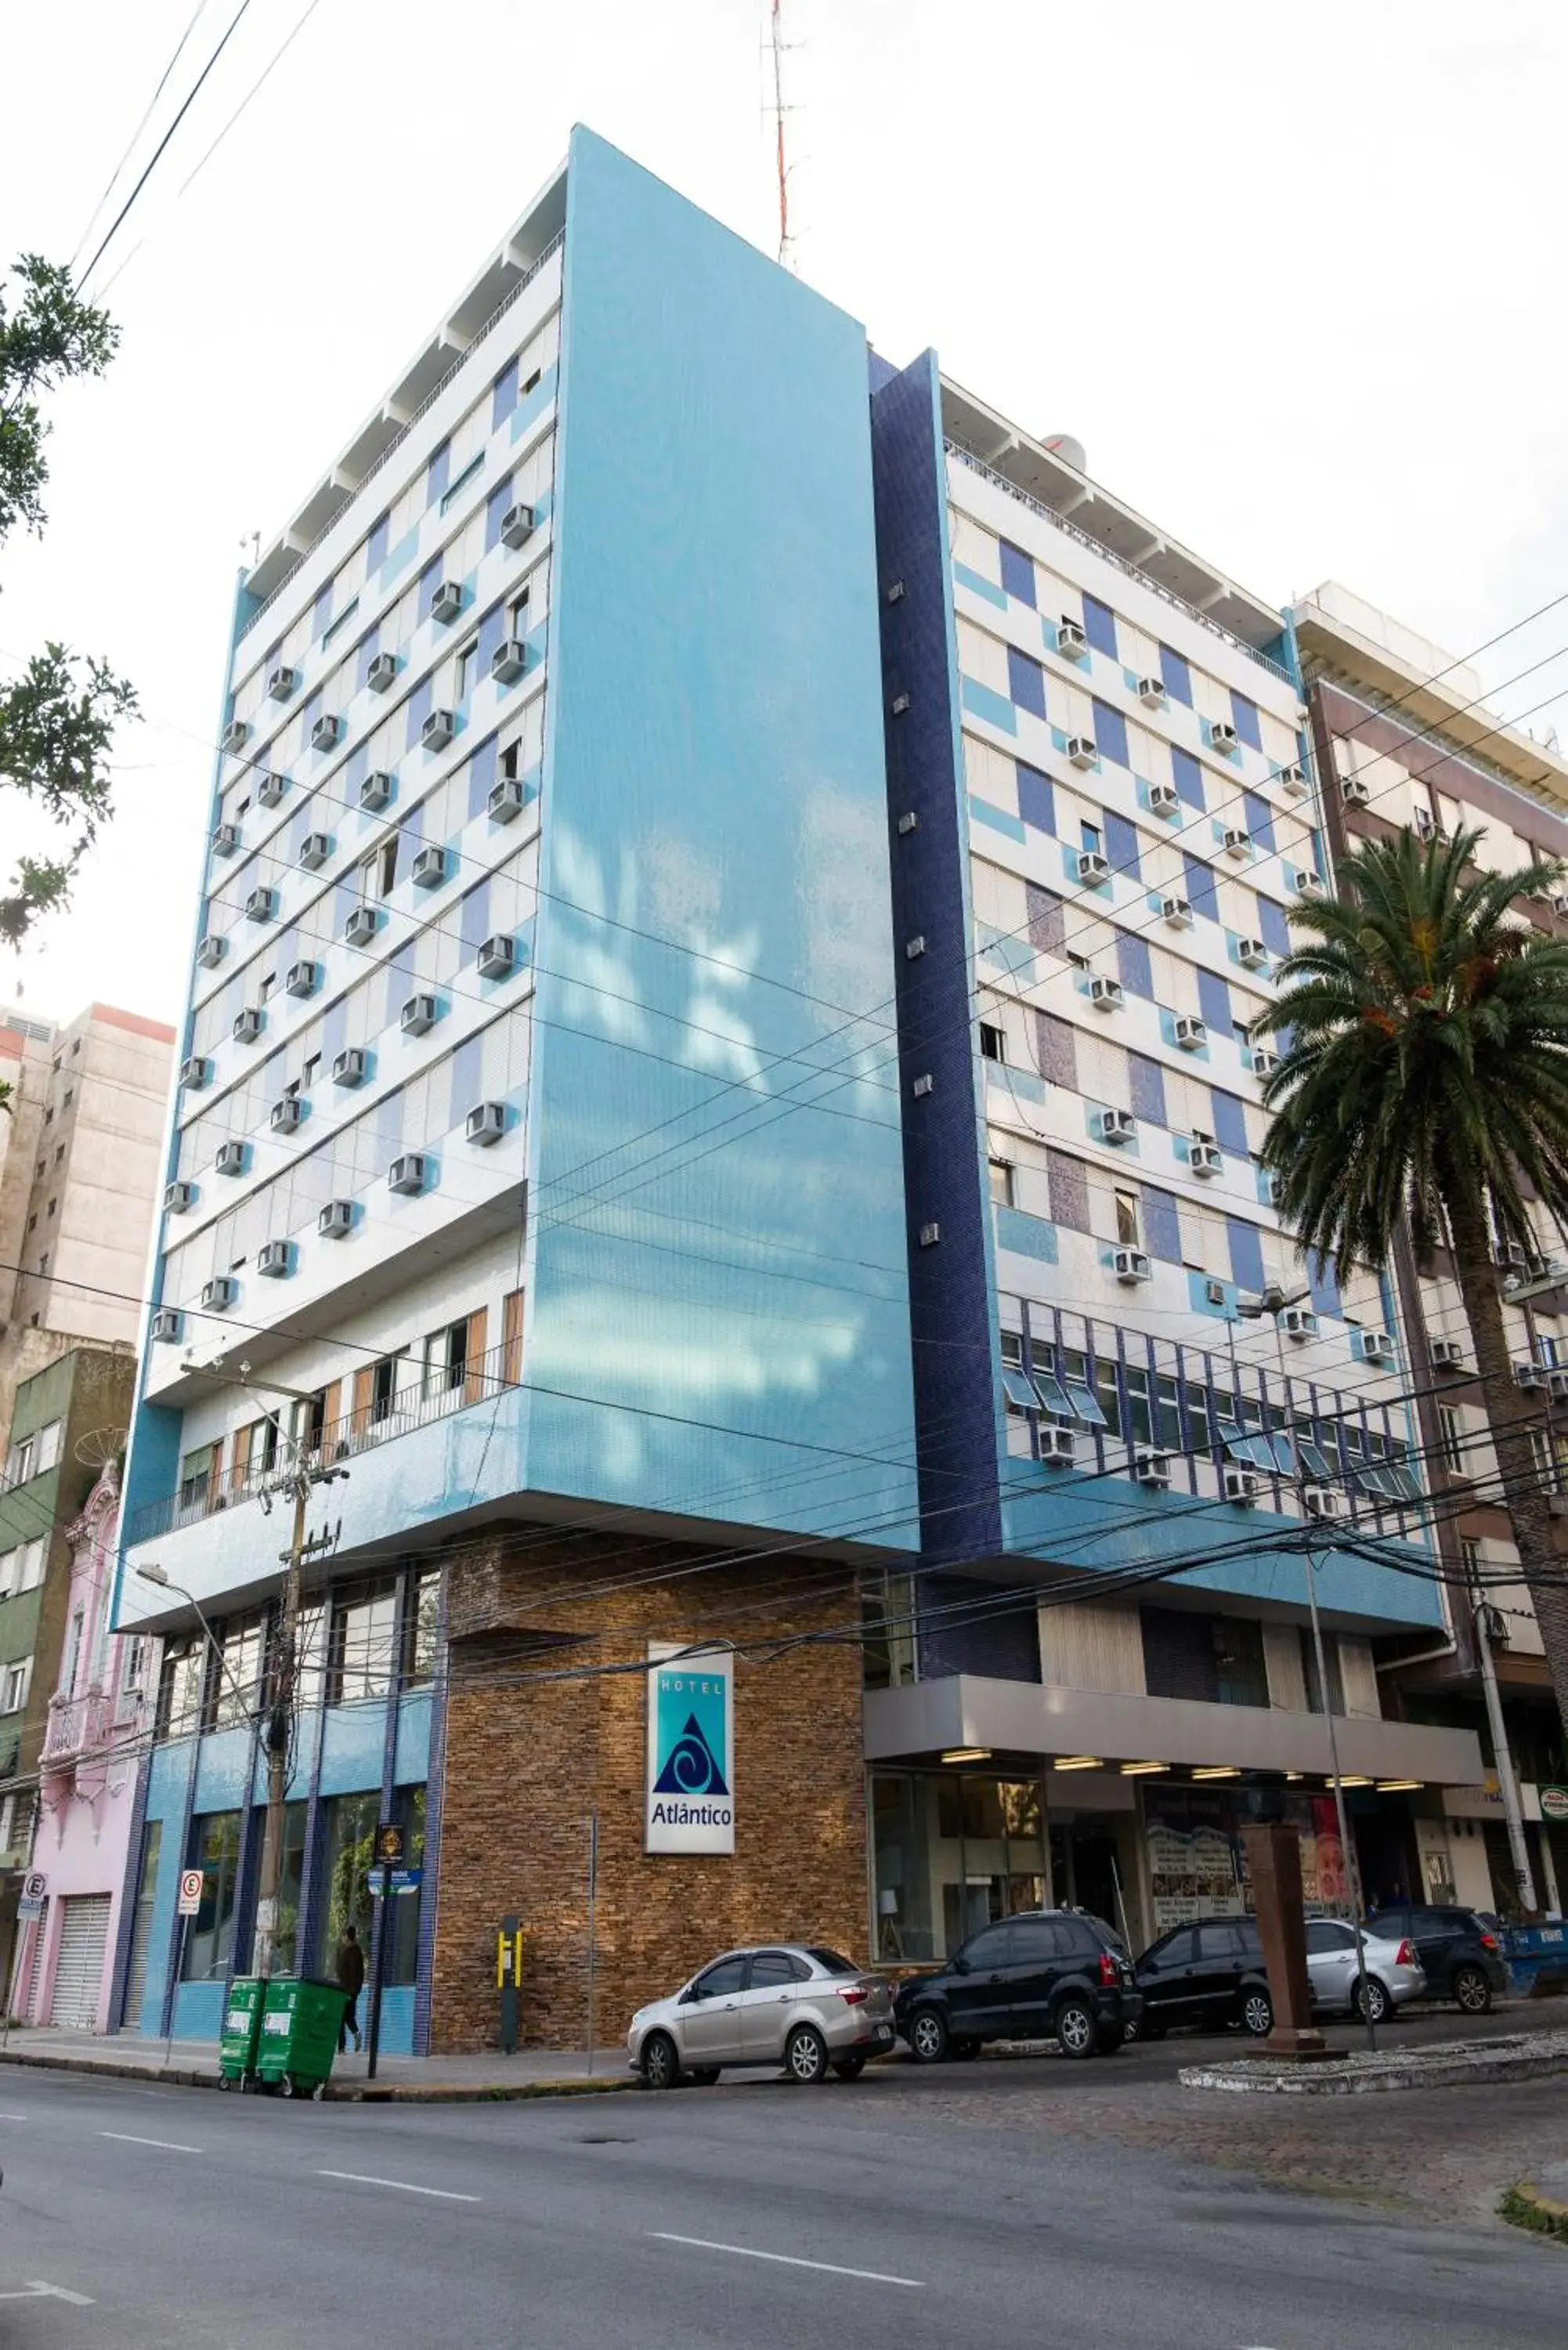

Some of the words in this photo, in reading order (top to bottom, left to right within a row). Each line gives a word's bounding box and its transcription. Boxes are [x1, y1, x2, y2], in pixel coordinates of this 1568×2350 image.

[661, 1679, 722, 1694] HOTEL
[652, 1802, 731, 1826] Atlântico
[31, 1878, 42, 1893] E
[189, 1878, 196, 1892] E
